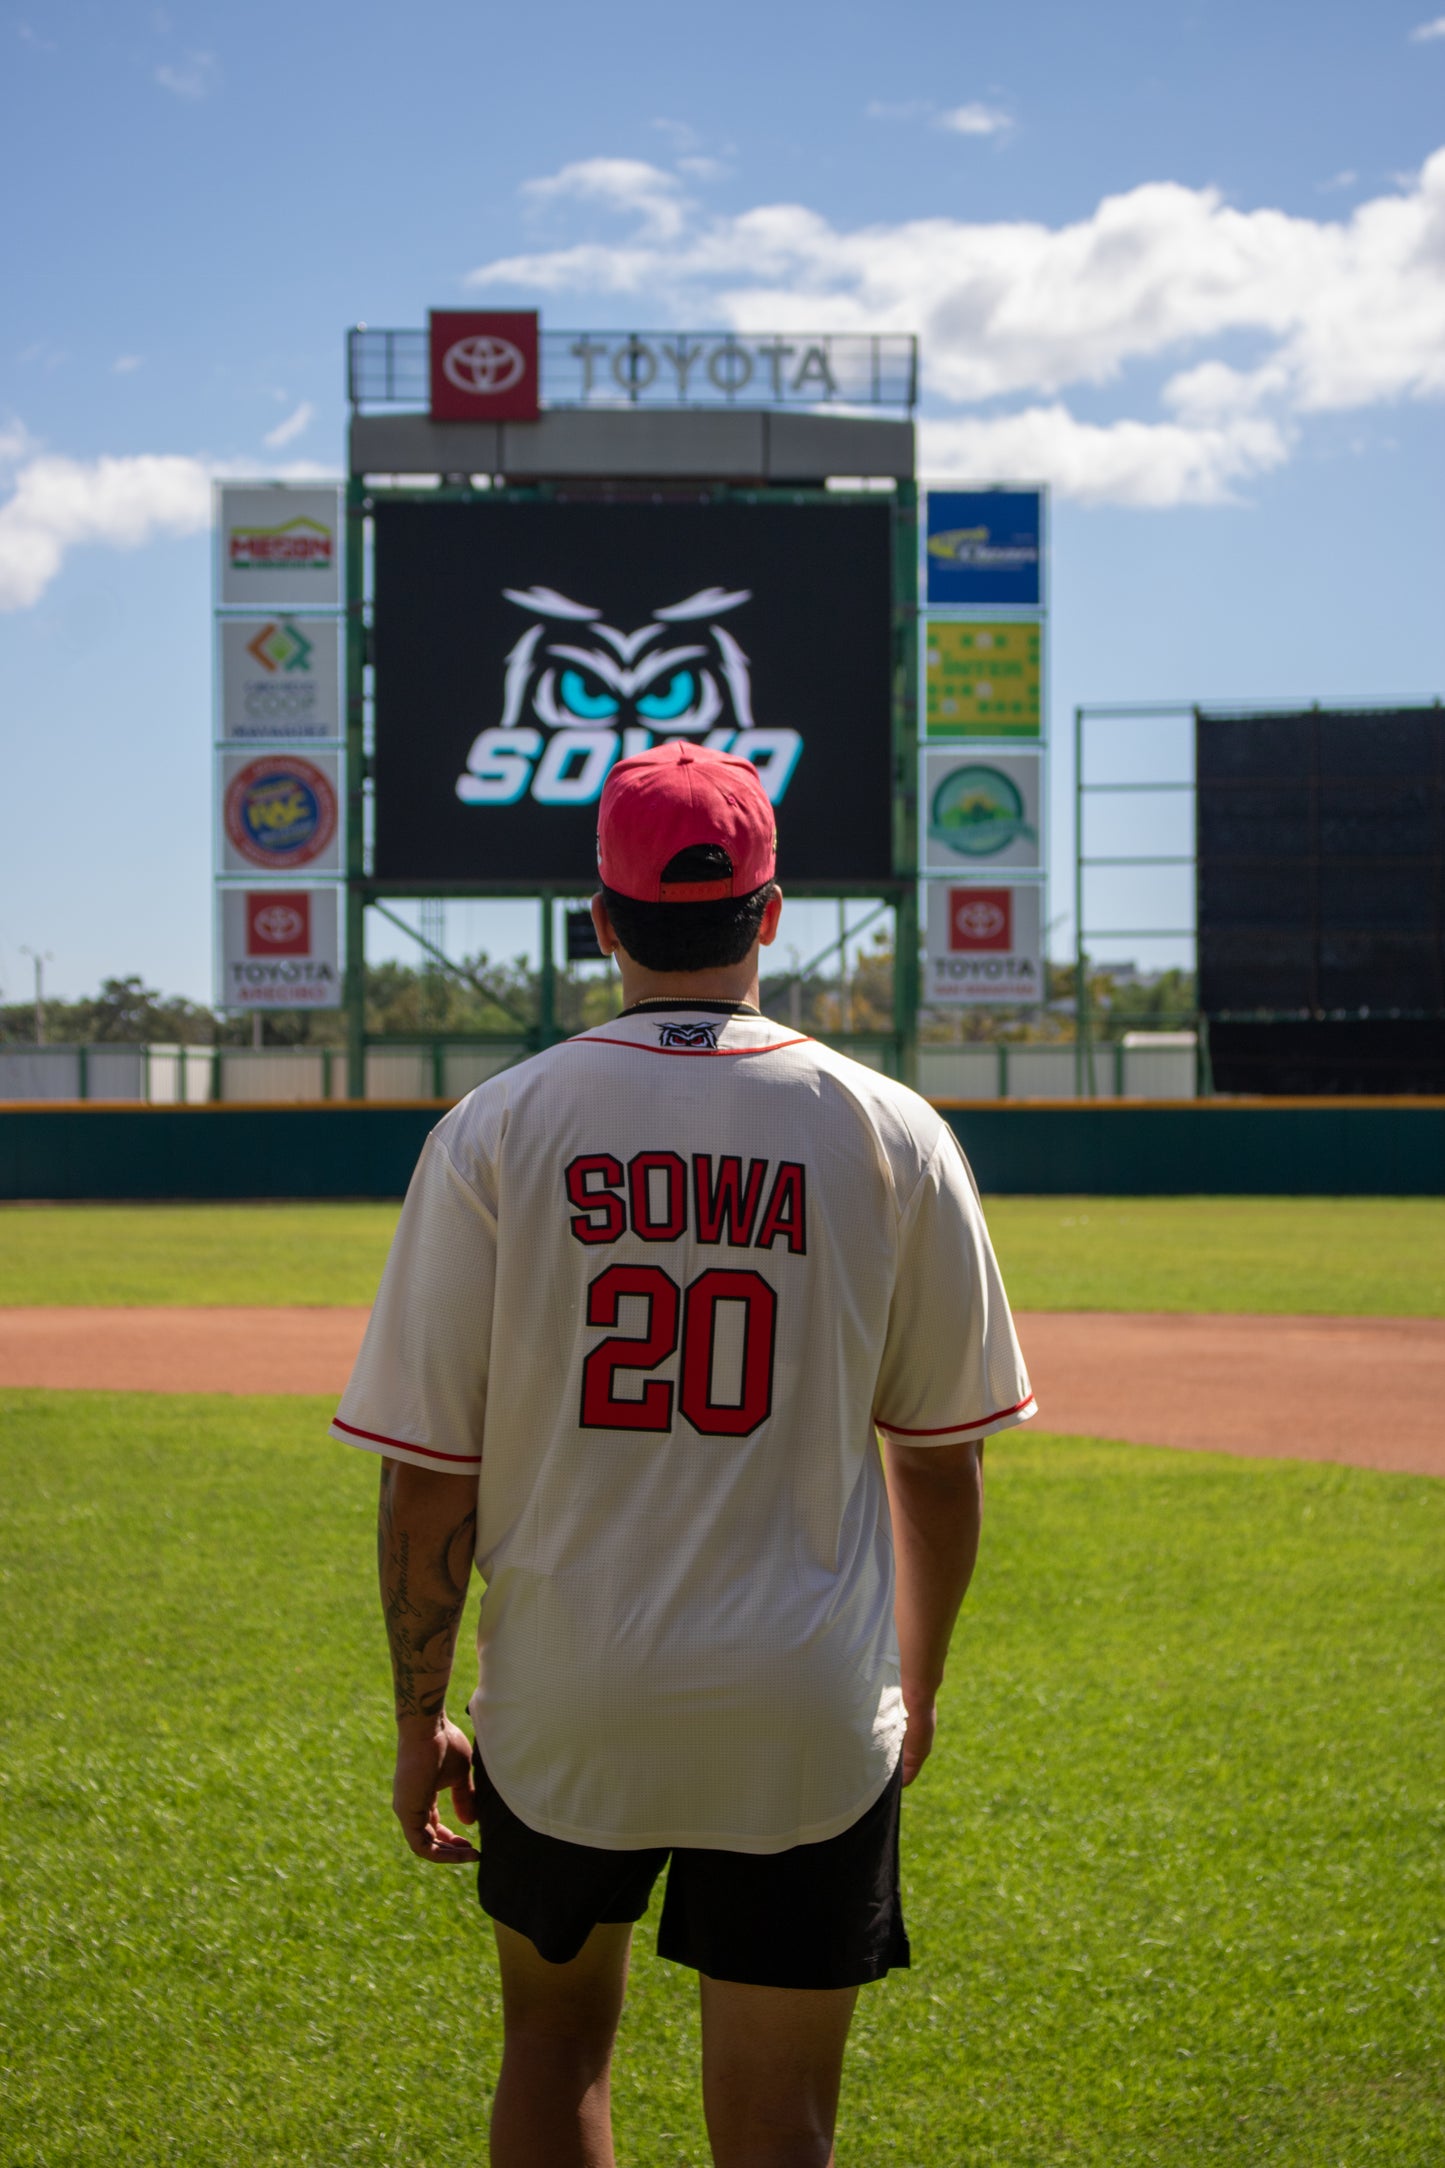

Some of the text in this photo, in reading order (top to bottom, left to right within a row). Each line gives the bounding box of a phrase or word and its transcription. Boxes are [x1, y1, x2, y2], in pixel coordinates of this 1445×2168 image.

[572, 342, 839, 393] TOYOTA
[231, 962, 334, 984] TOYOTA
[933, 957, 1036, 980] TOYOTA
[564, 1150, 807, 1255] SOWA
[579, 1263, 777, 1437] 20
